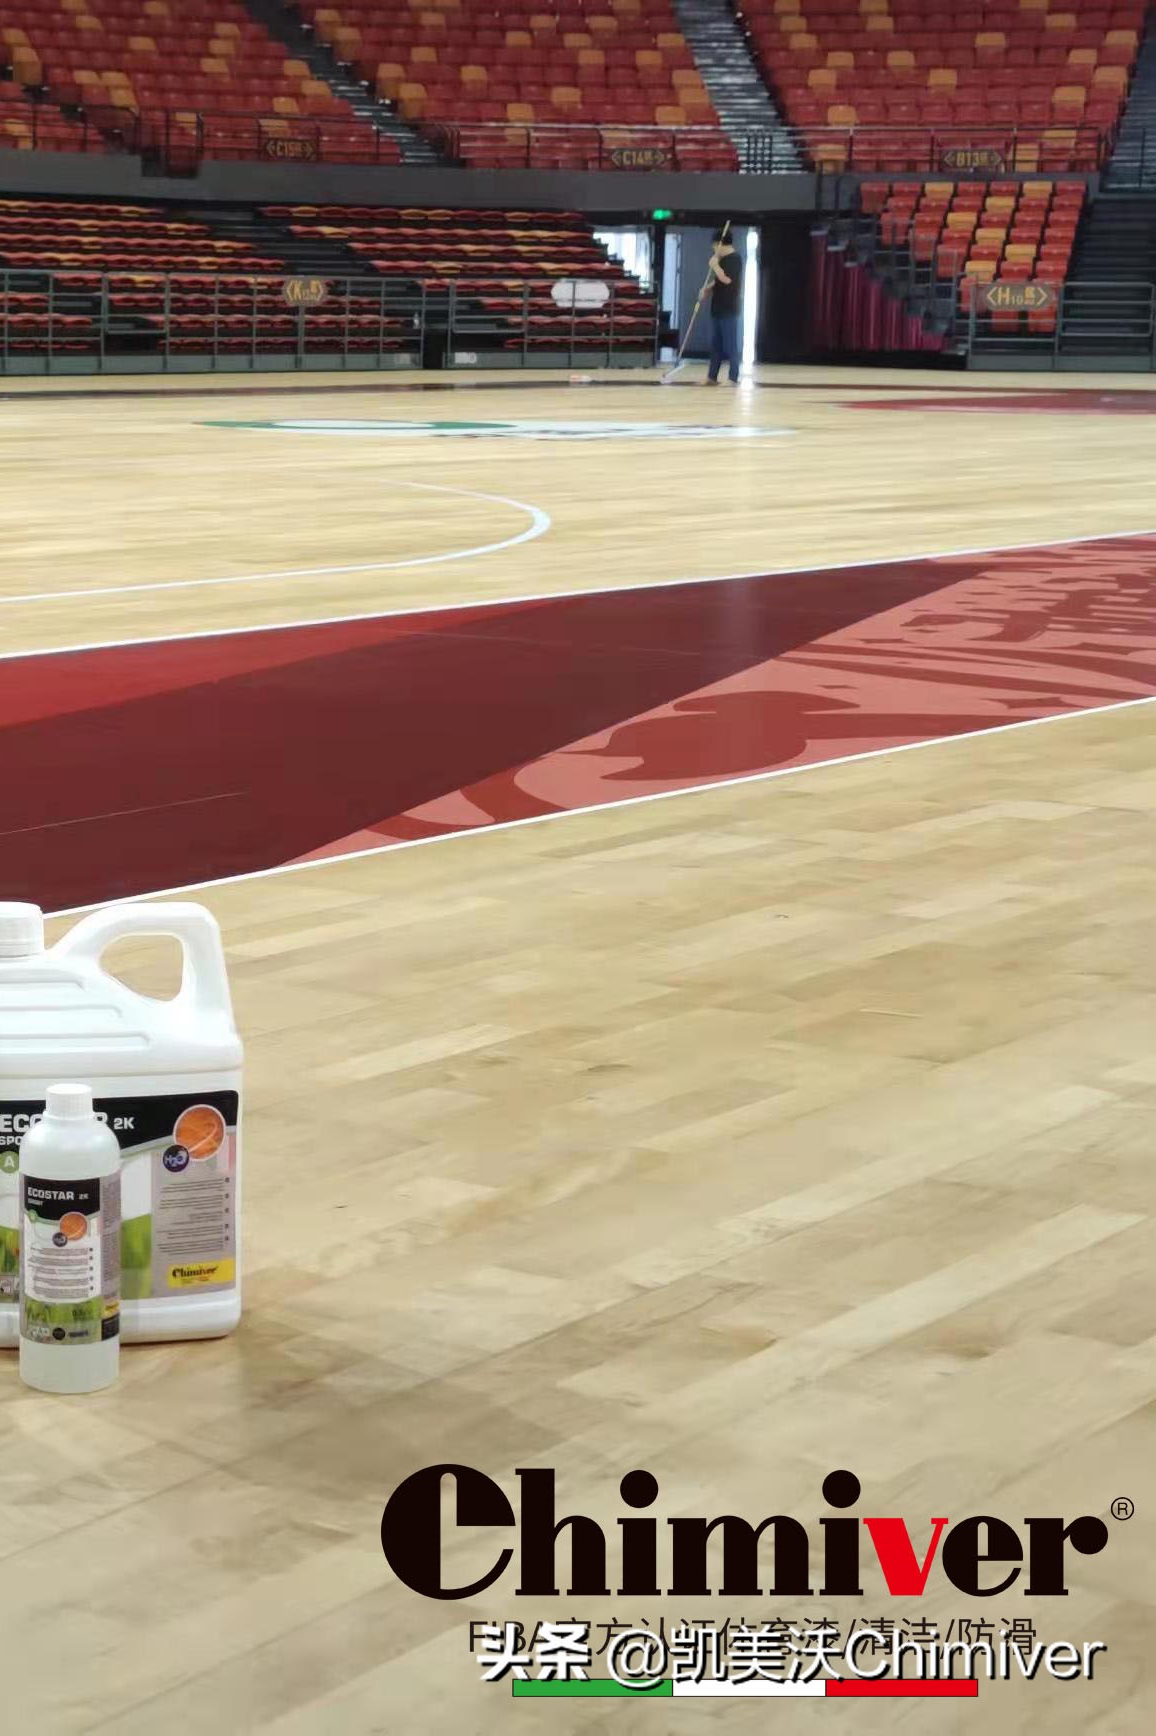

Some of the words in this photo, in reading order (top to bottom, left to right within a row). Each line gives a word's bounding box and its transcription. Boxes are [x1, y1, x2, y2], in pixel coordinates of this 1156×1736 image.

[113, 1117, 135, 1130] 2K
[4, 1155, 15, 1168] A
[27, 1186, 75, 1201] ECOSTAR
